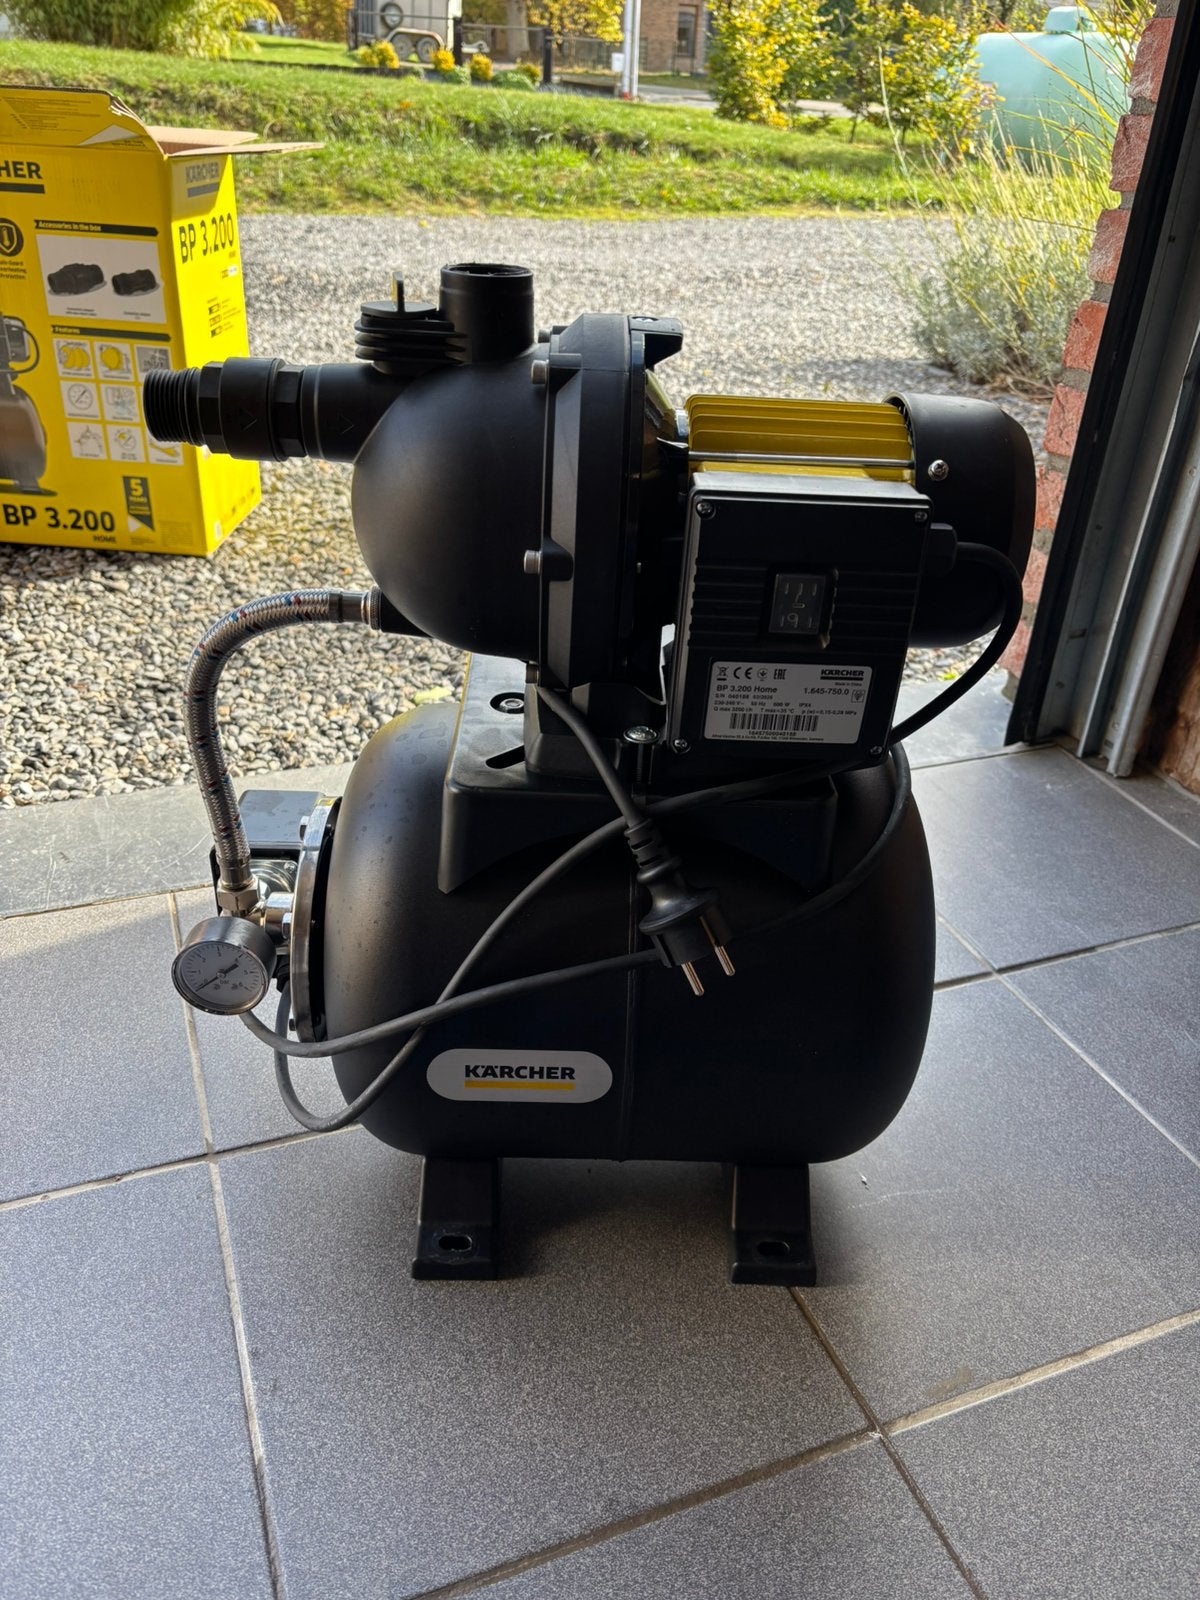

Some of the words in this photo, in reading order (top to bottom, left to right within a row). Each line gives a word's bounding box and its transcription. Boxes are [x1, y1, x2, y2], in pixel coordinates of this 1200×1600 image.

[178, 223, 196, 264] BP
[199, 212, 235, 256] 3.200
[130, 478, 143, 496] 5
[3, 503, 37, 527] BP
[44, 506, 115, 533] 3.200
[716, 684, 728, 692] BP
[804, 687, 850, 696] 1.645-750.0
[464, 1064, 576, 1080] KÄRCHER
